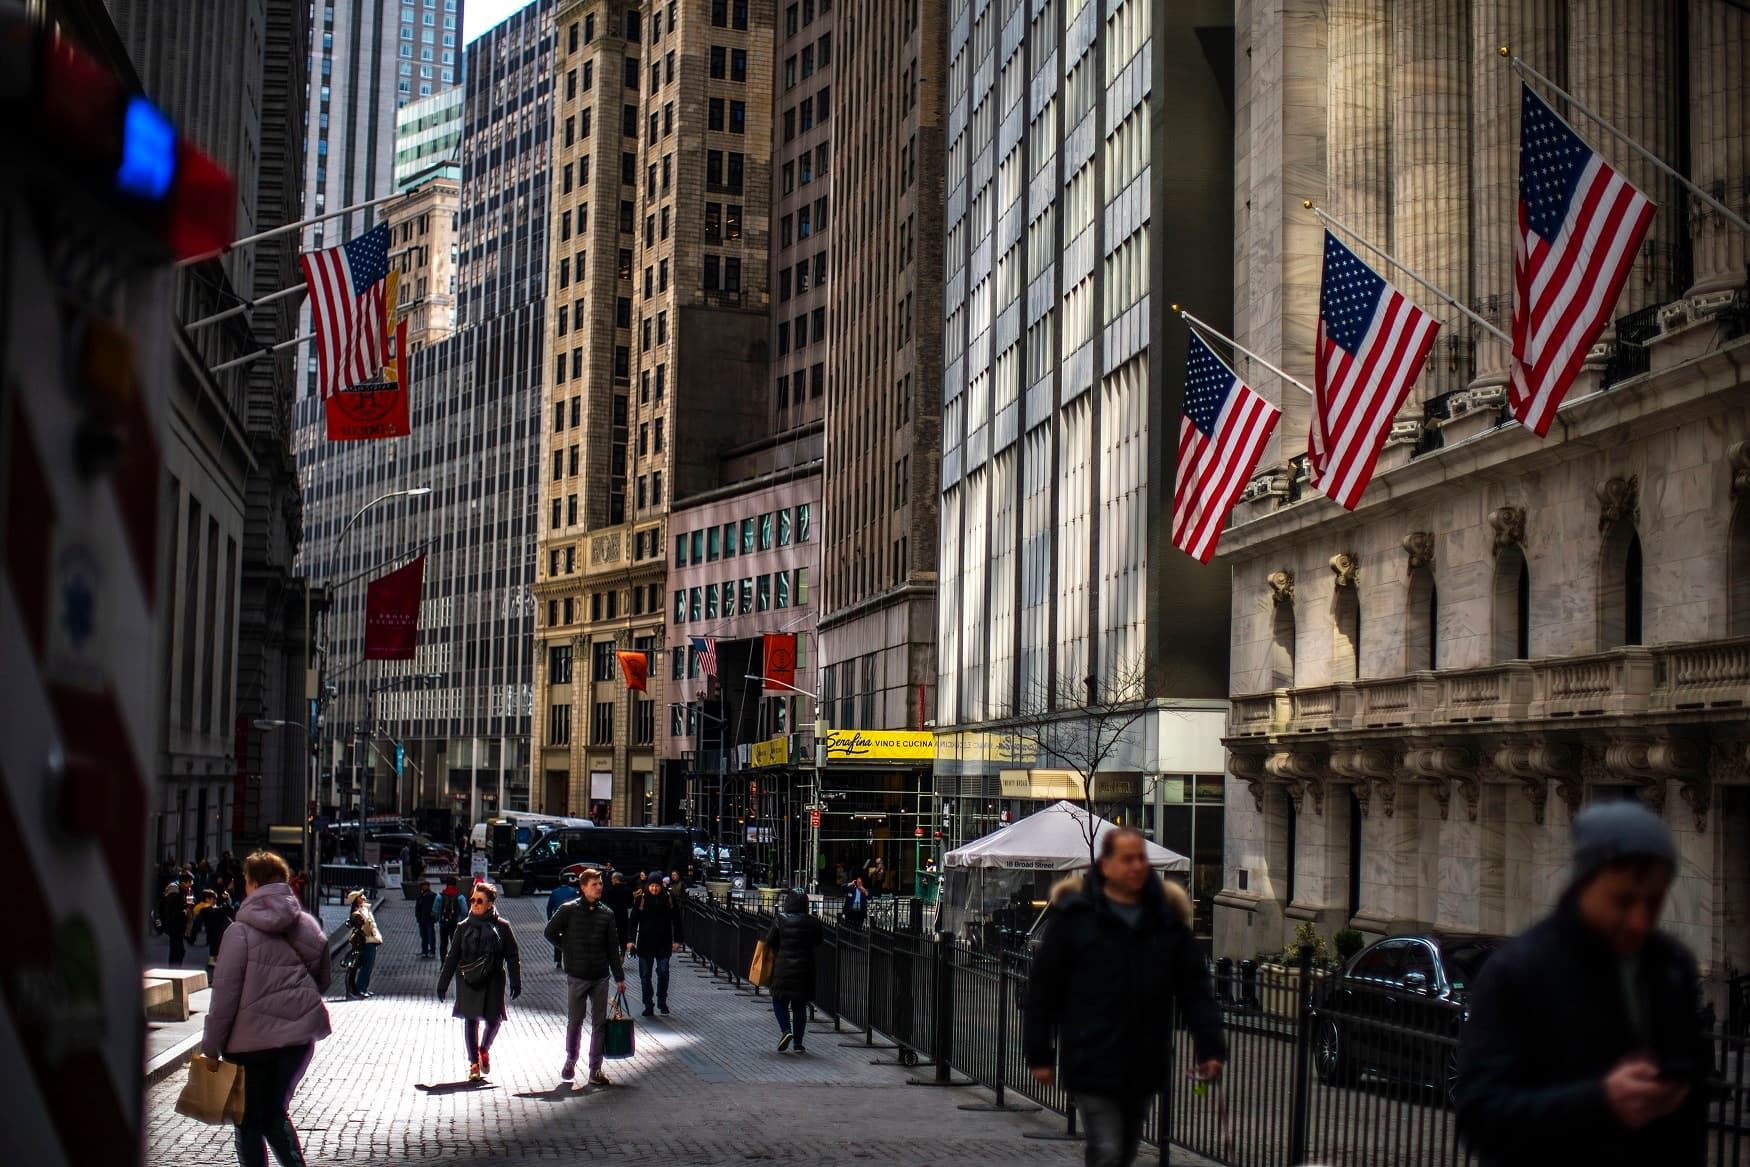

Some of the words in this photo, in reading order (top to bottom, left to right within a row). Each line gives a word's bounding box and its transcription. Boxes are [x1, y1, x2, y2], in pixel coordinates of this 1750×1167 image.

[827, 732, 872, 755] Serafina
[875, 740, 894, 748] VINO
[896, 740, 901, 748] E
[902, 739, 933, 748] CUCINA
